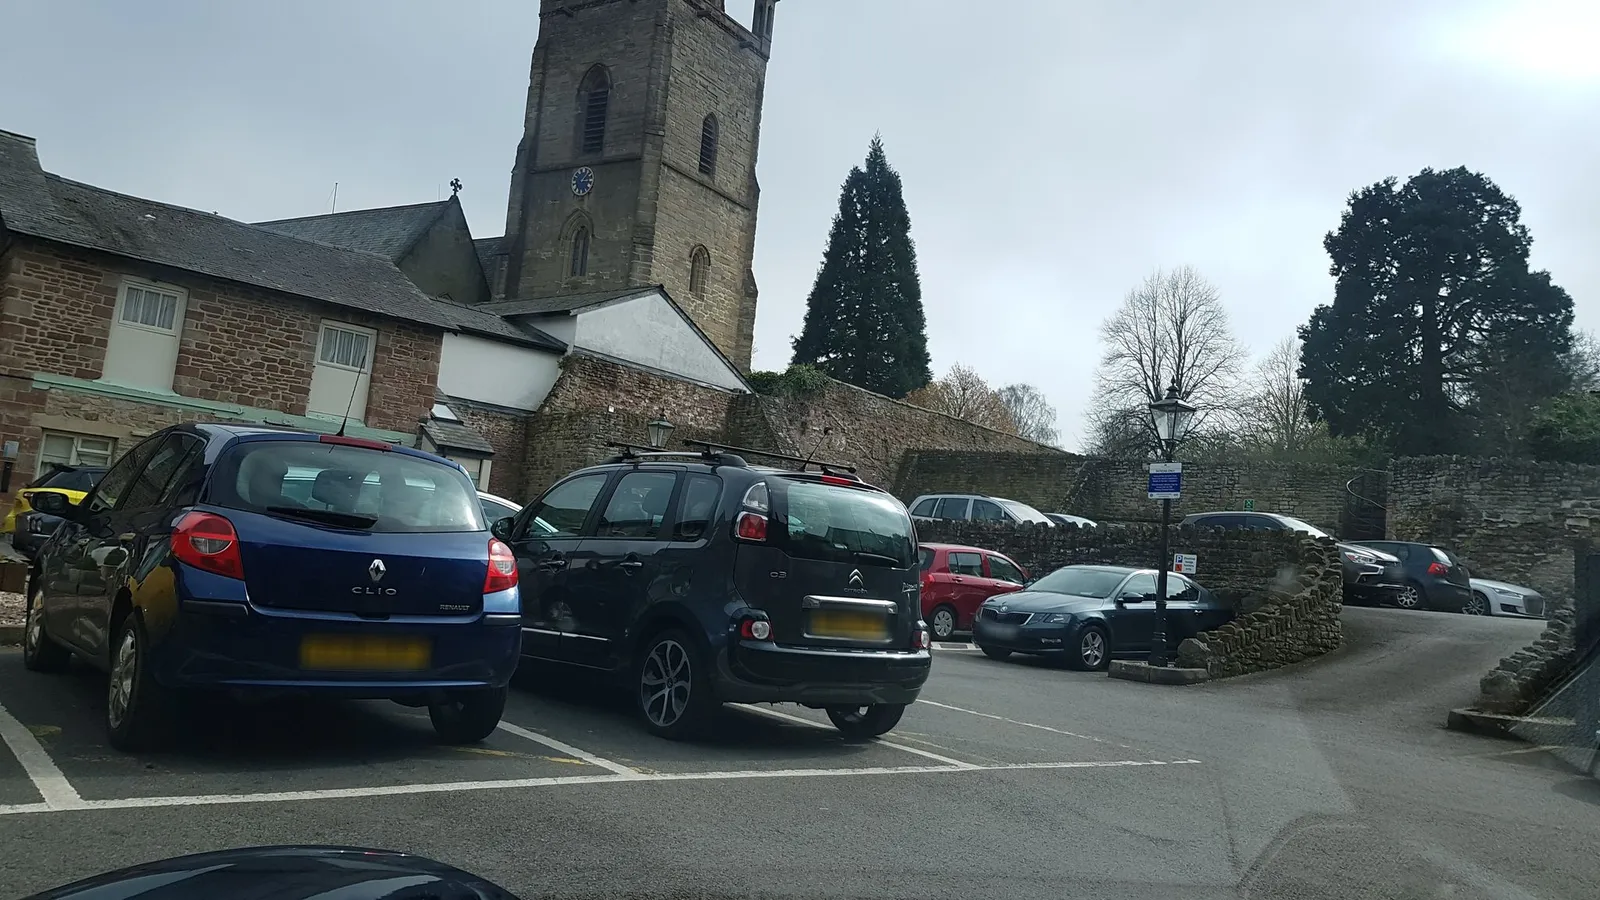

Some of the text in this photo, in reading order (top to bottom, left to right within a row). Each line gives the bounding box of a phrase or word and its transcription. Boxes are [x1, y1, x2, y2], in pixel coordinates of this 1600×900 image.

[1177, 555, 1182, 563] P
[769, 571, 787, 579] C3
[351, 586, 397, 596] CLIO
[439, 603, 470, 611] RENAULT
